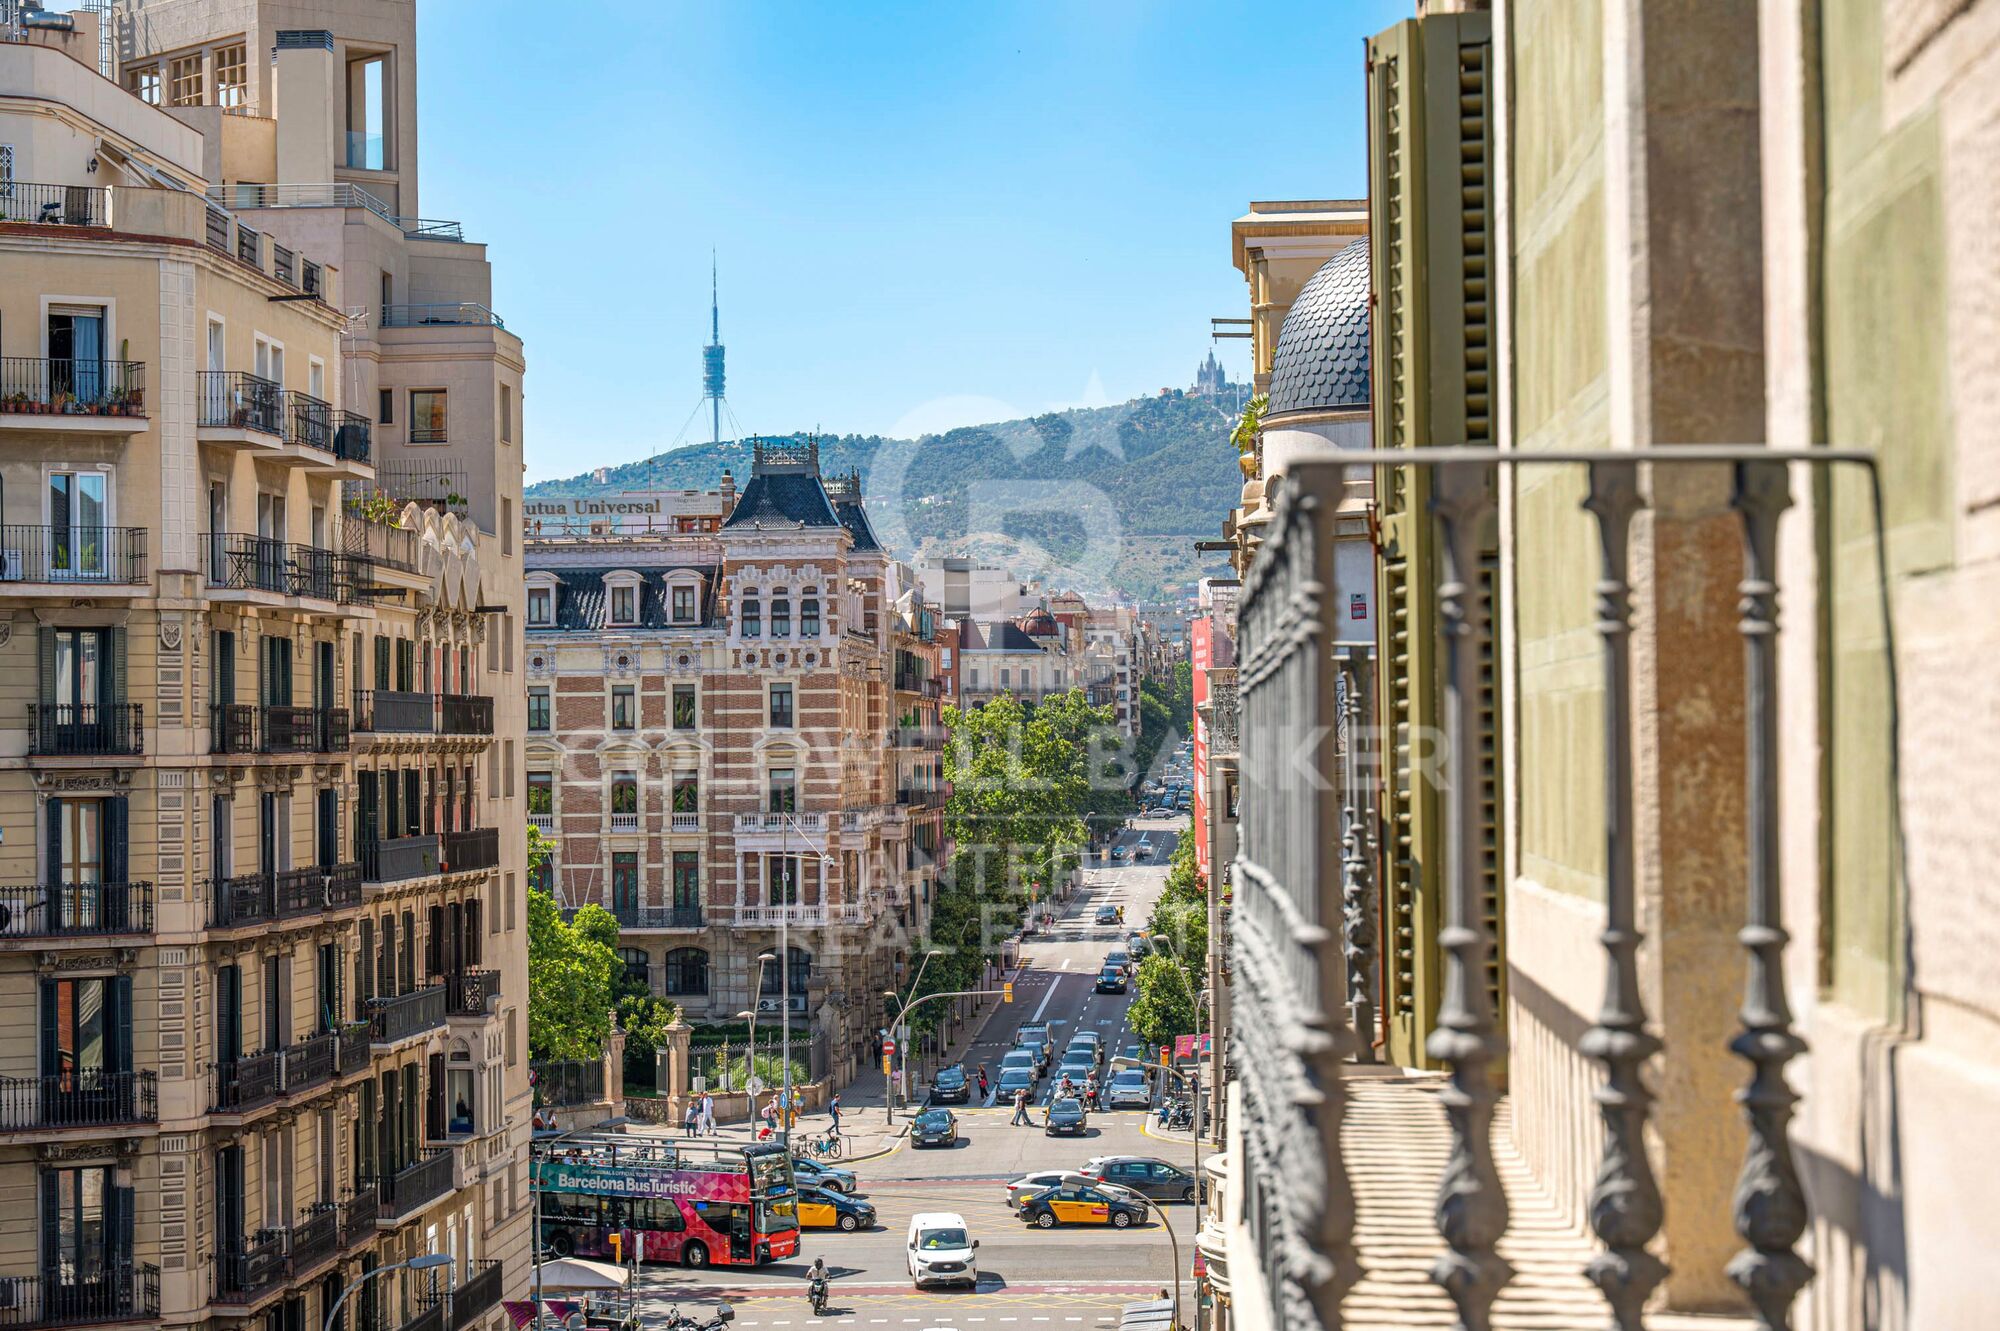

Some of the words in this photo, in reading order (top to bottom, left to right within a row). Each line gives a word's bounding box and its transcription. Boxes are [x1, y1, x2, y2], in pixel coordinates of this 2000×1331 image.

[523, 501, 567, 515] utua
[574, 499, 661, 515] Universal
[558, 1173, 624, 1191] Barcelona
